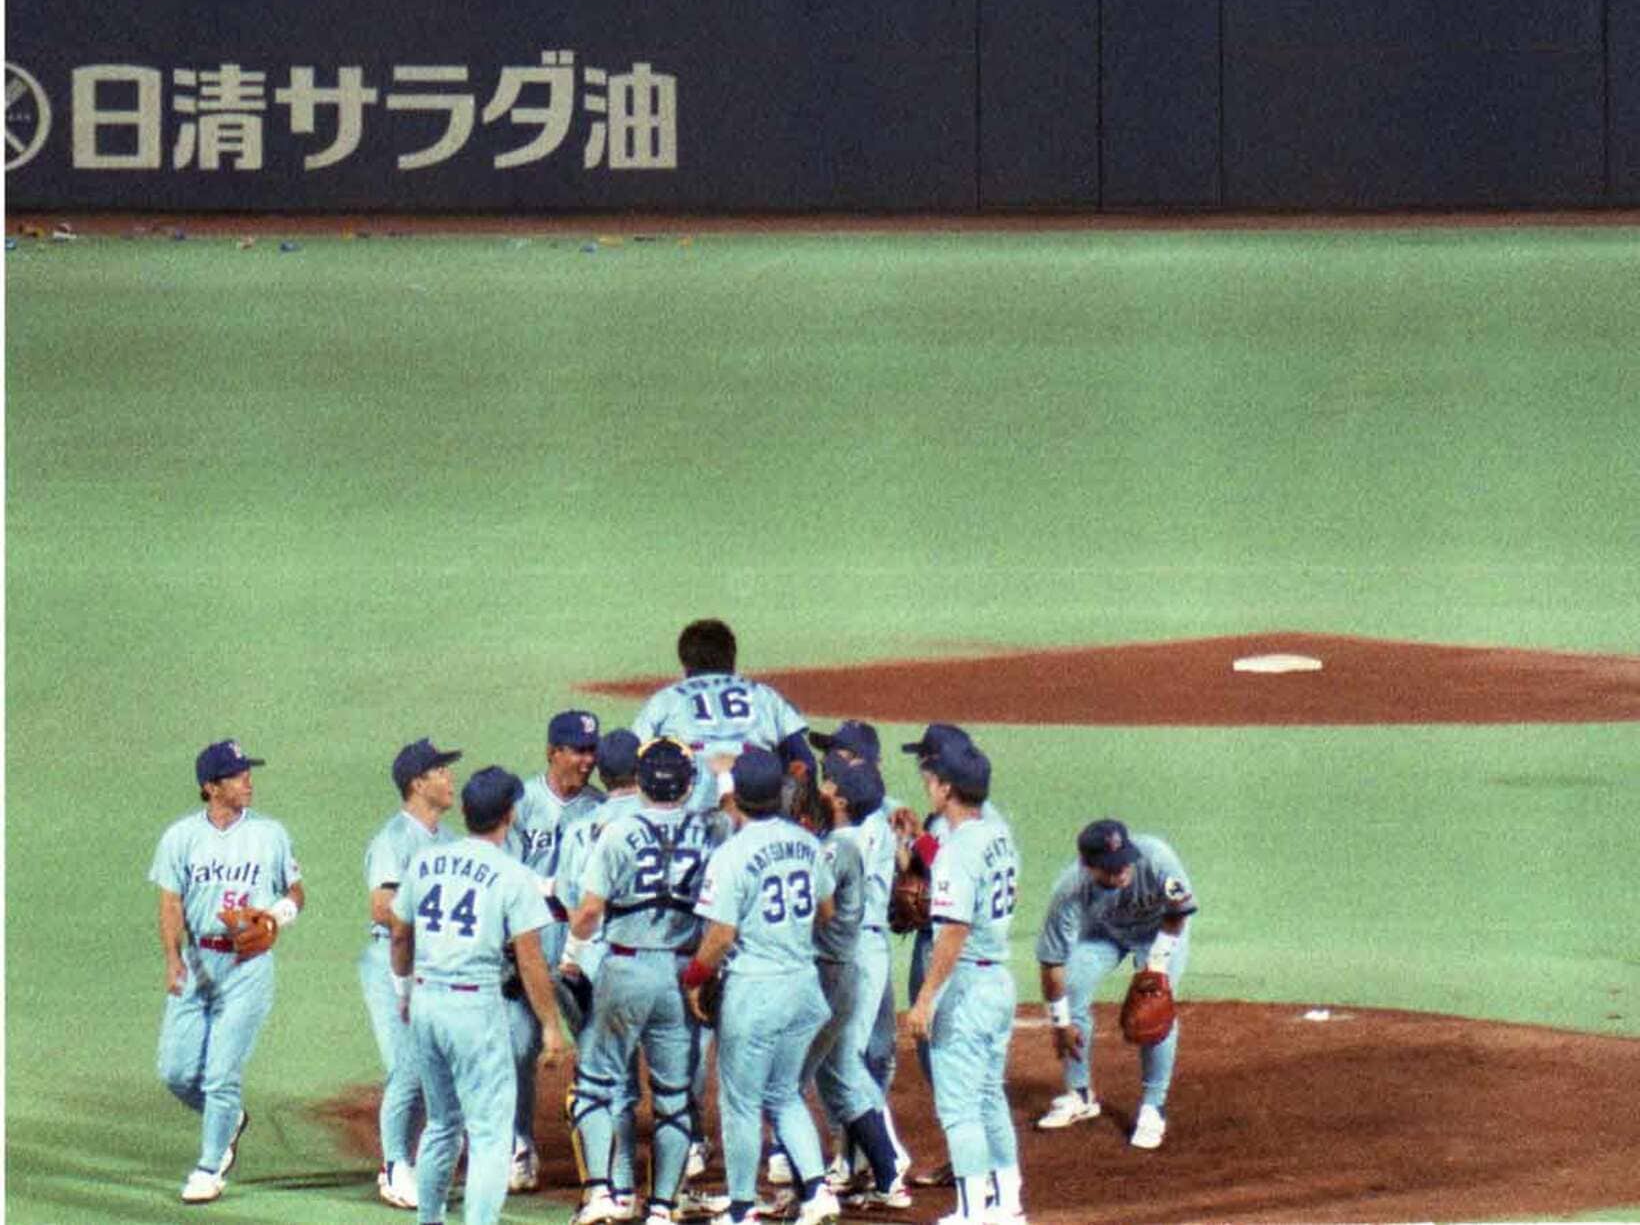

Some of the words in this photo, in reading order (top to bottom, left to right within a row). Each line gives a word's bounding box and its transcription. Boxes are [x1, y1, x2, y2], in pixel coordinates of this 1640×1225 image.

[71, 50, 678, 170] 日清サラダ油
[691, 686, 750, 720] 16
[635, 847, 702, 895] 27
[763, 870, 813, 923] 33
[417, 884, 477, 937] 44
